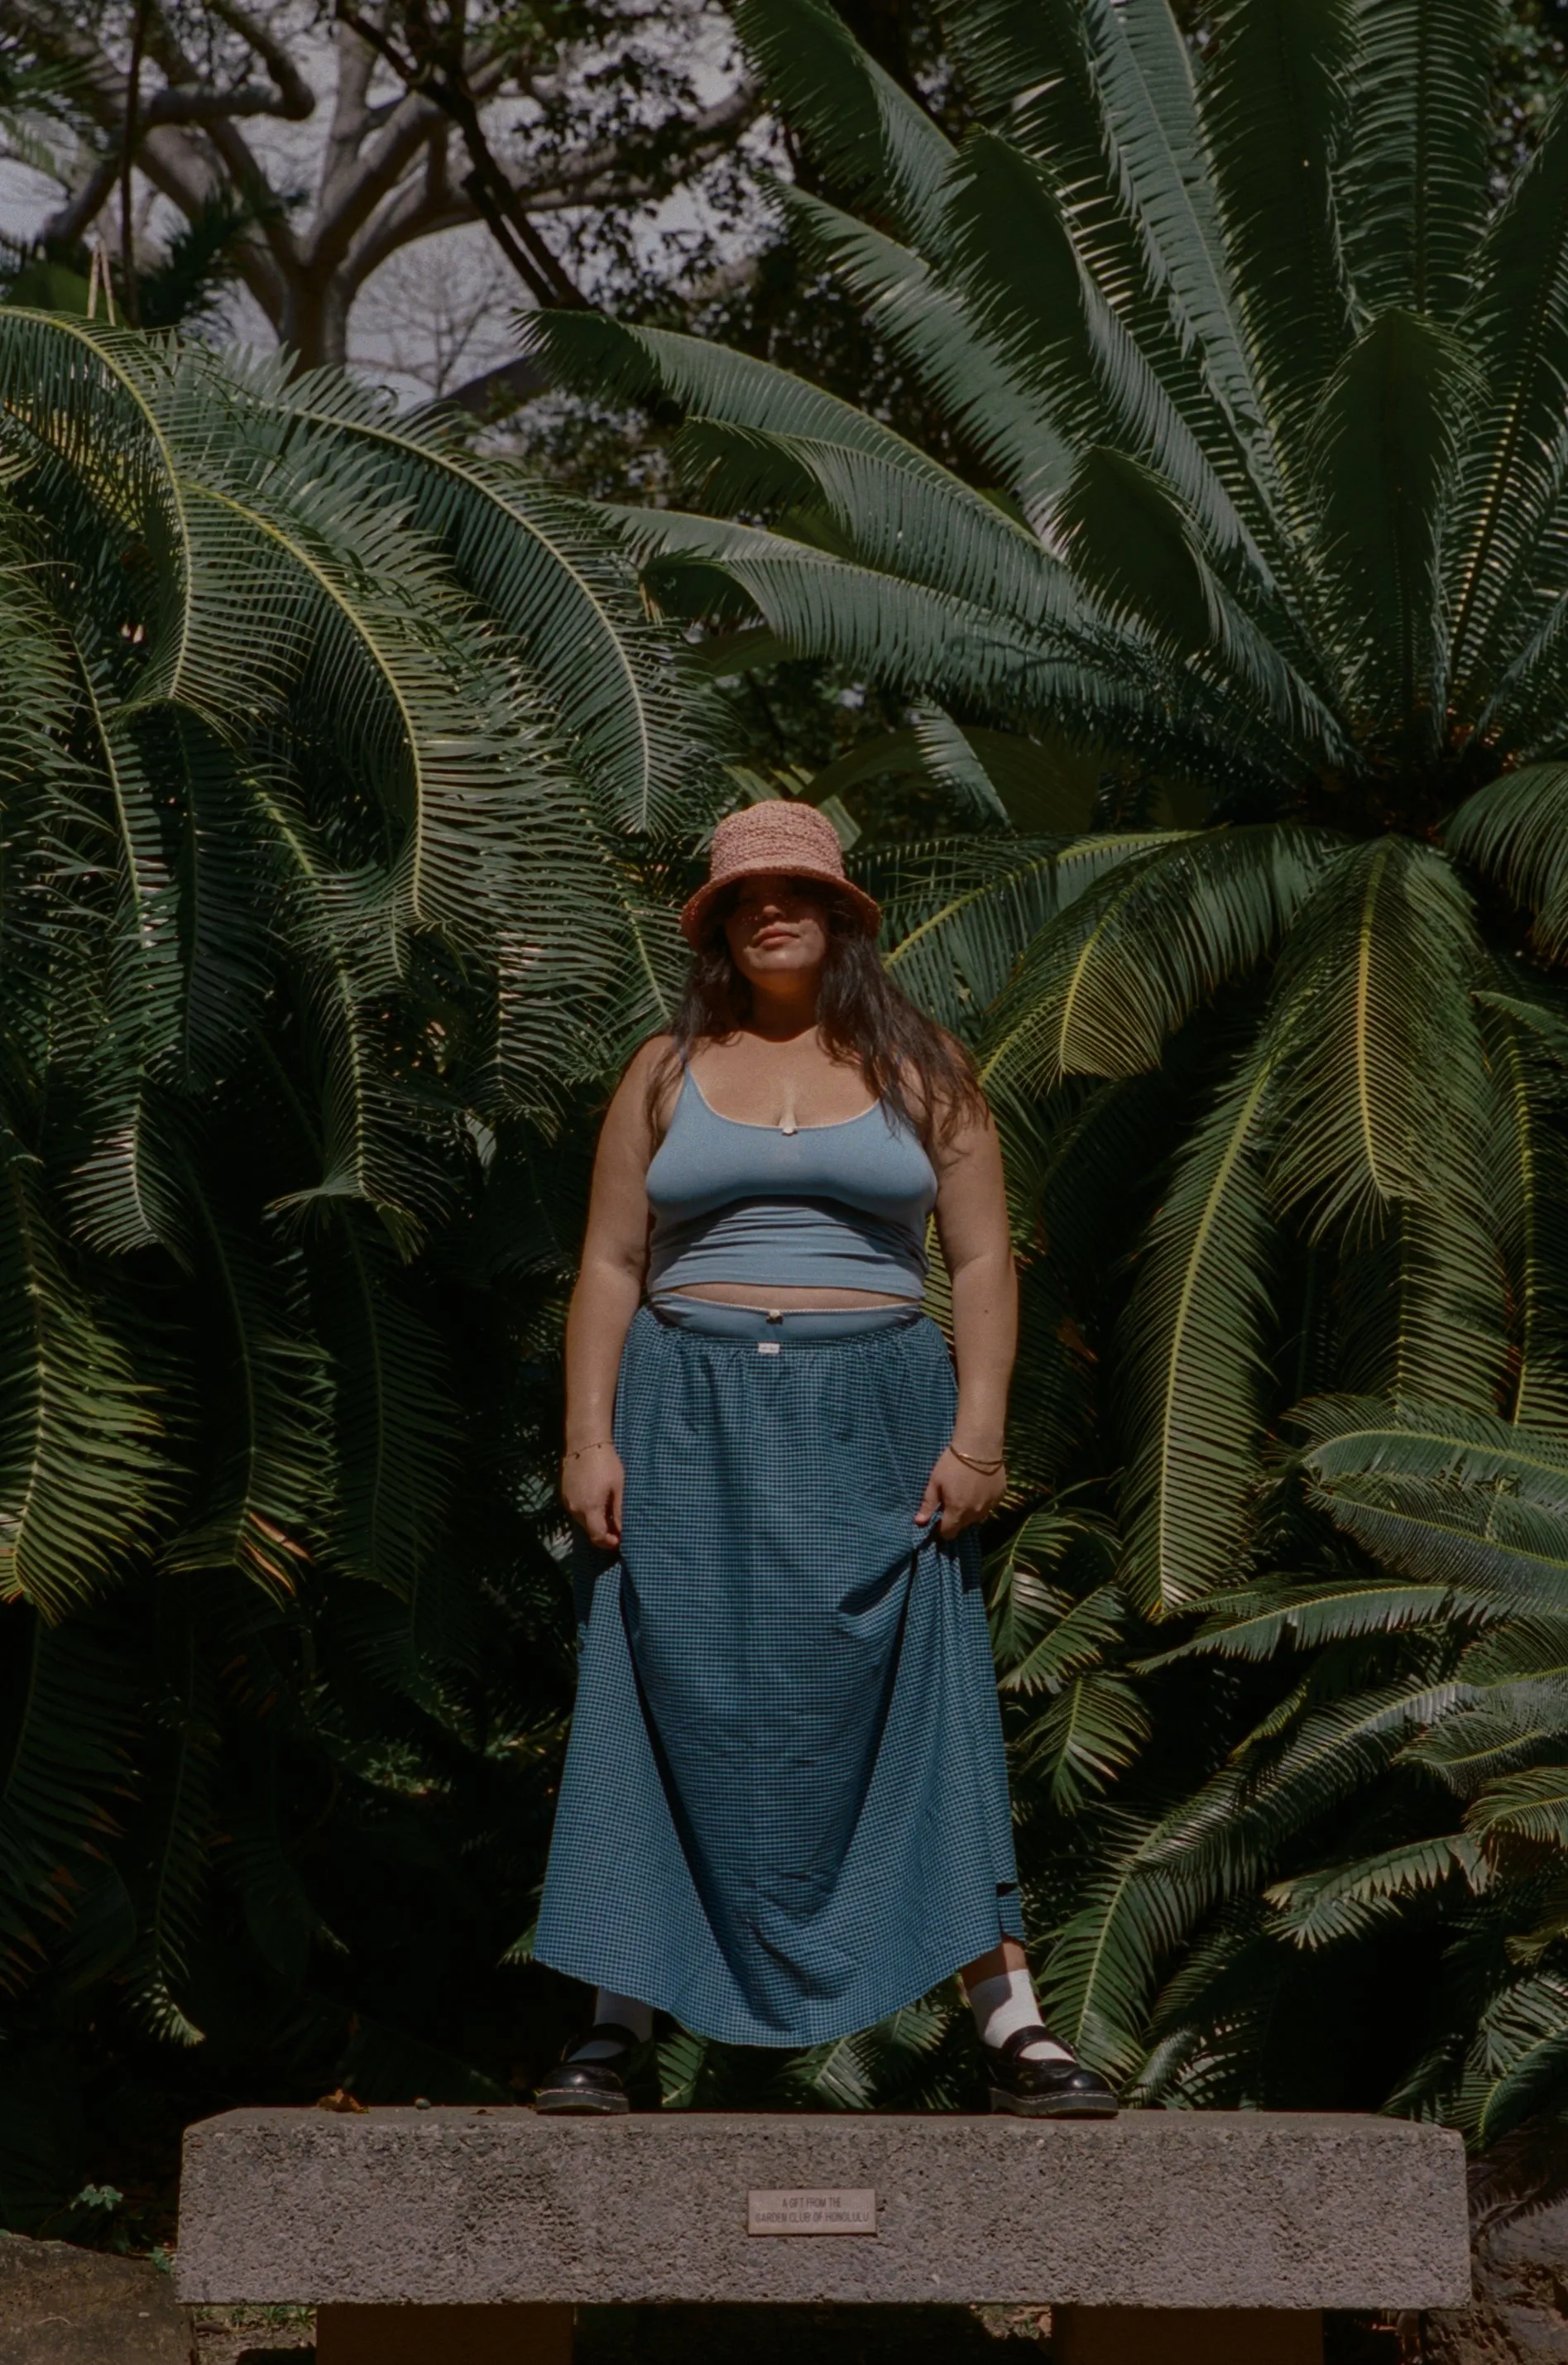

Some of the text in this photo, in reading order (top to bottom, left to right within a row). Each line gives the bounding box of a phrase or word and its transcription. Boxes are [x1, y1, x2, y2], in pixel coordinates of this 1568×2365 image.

[782, 2197, 787, 2208] A
[806, 2197, 826, 2208] FROM
[829, 2197, 842, 2208] THE
[755, 2211, 869, 2223] GARDEN CLUB OF HONOLULU
